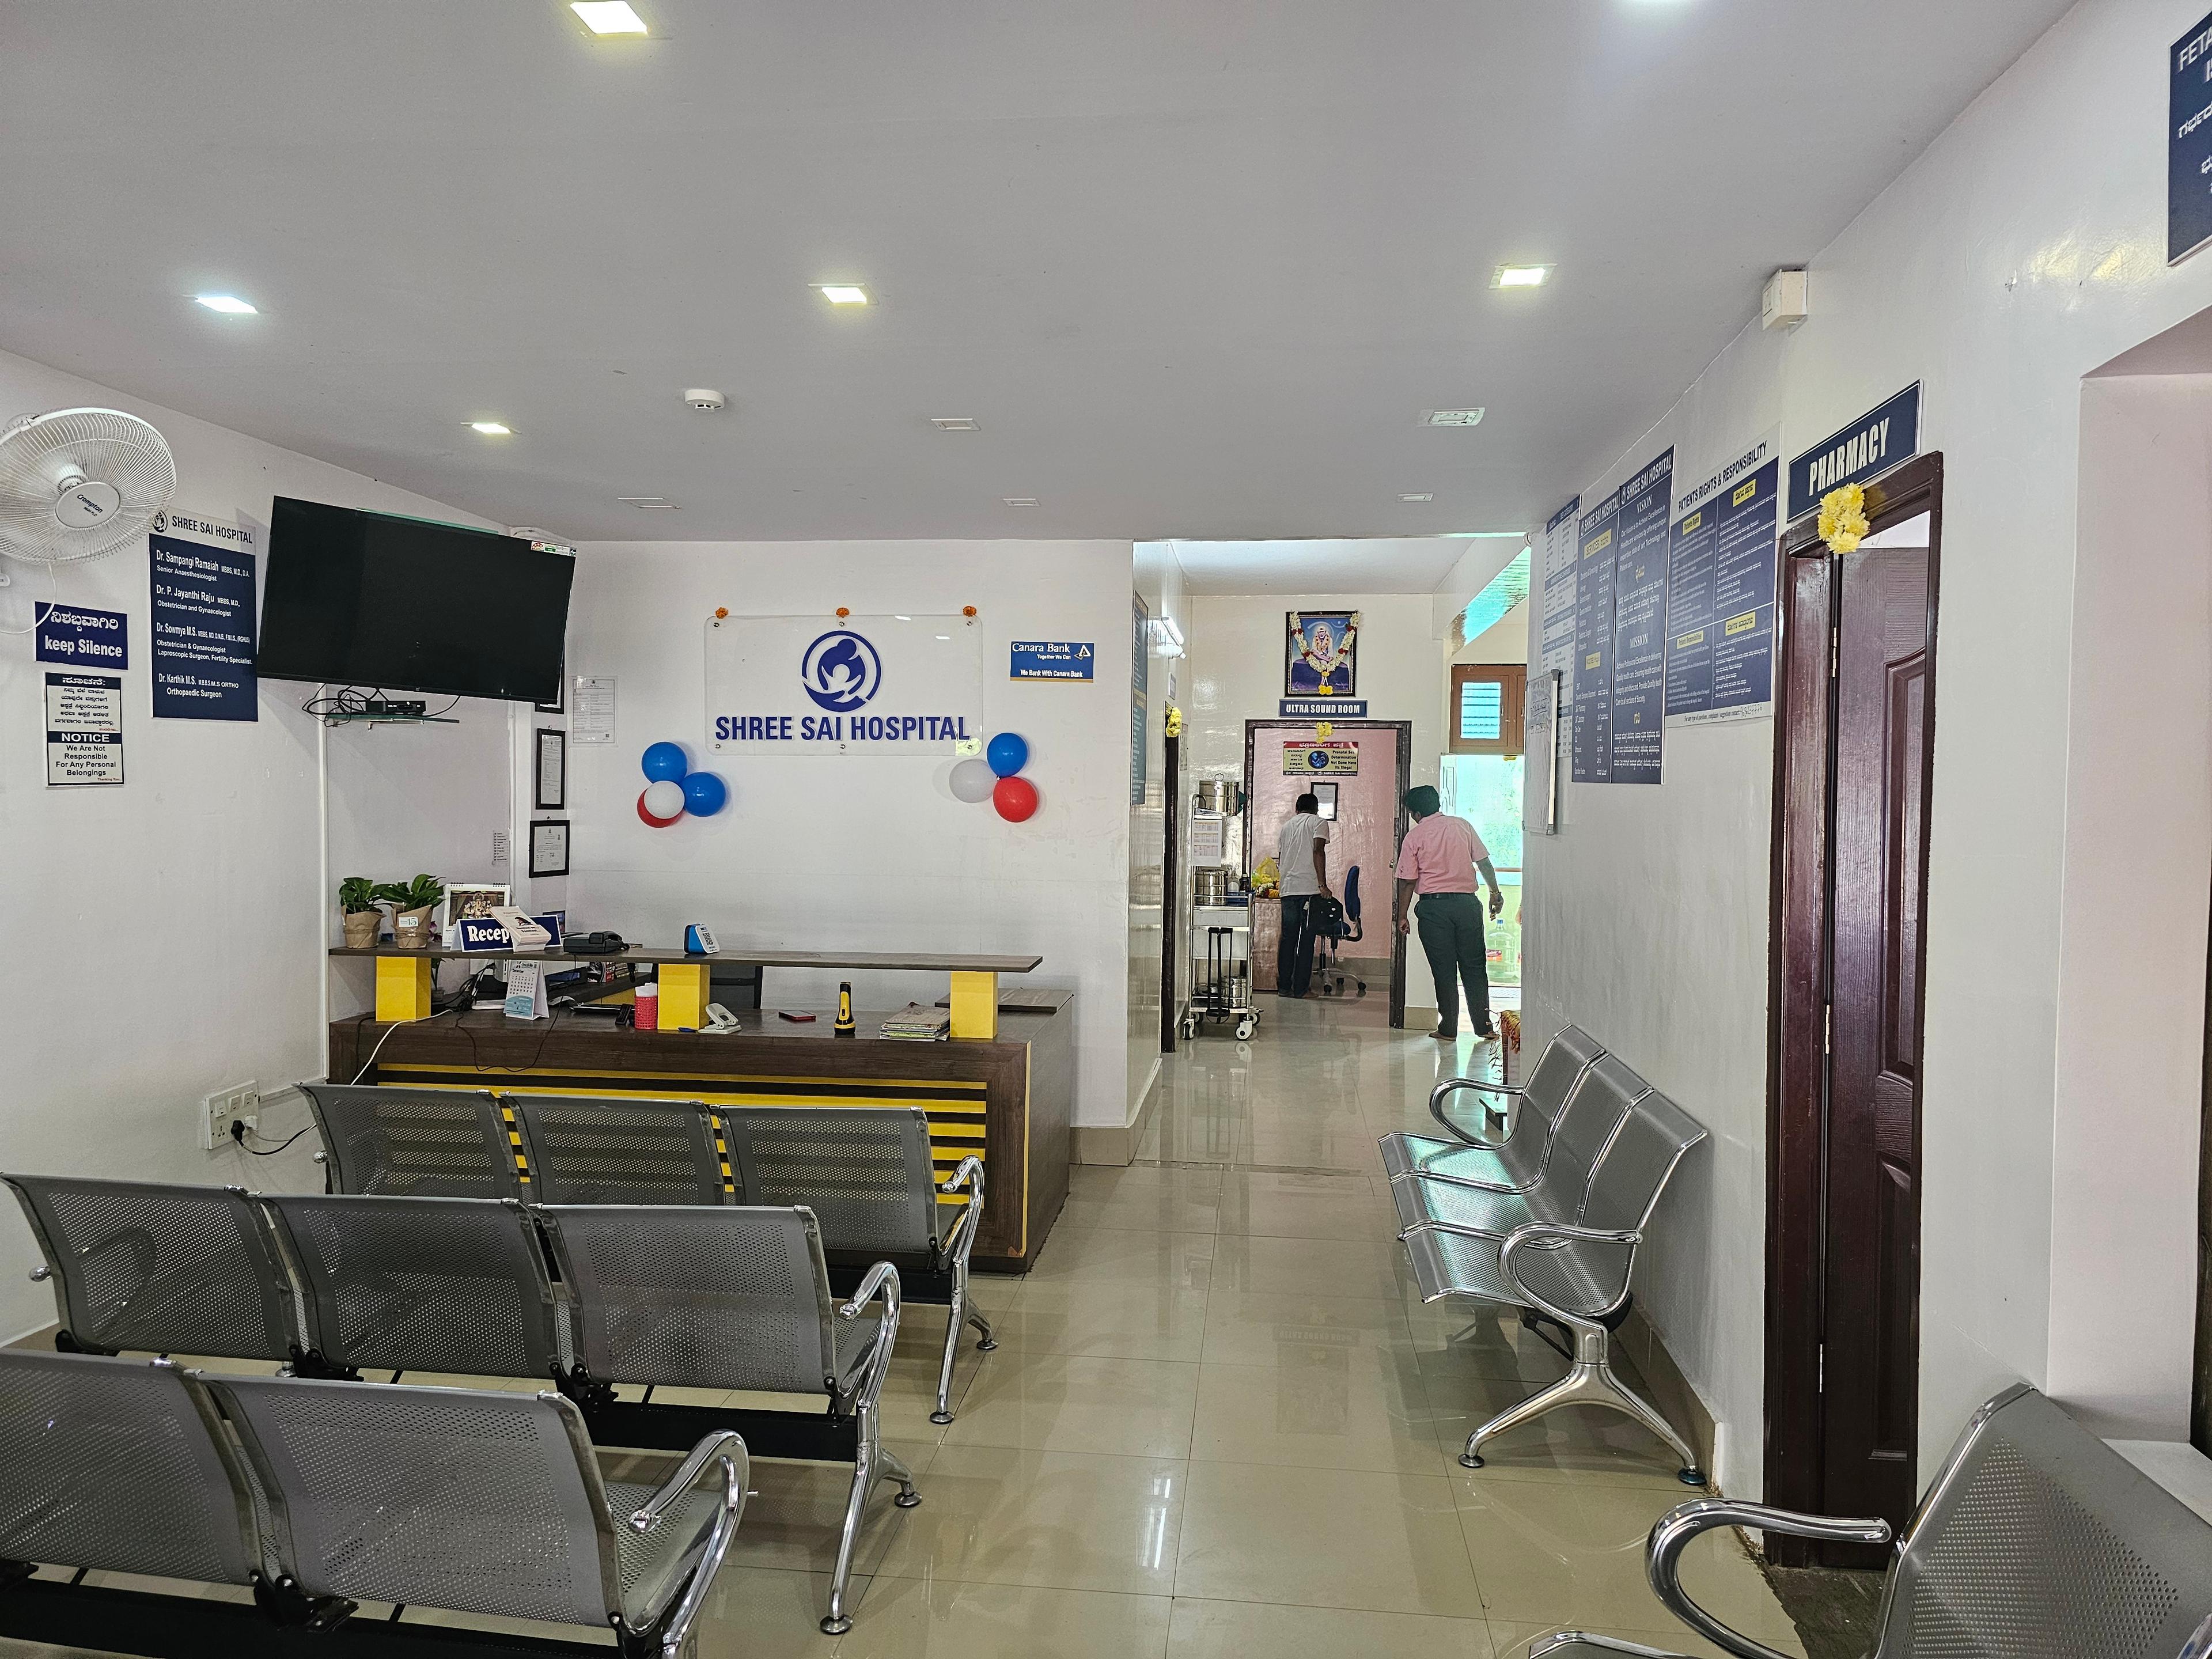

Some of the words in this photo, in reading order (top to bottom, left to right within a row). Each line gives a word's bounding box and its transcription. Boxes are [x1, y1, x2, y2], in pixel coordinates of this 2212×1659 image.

[1809, 417, 1889, 497] PHARMACY
[1627, 478, 1640, 500] SHREE
[1649, 454, 1672, 483] HOSPITAL
[1679, 488, 1698, 513] PATIENTS
[1699, 476, 1717, 499] RIGHTS
[1718, 472, 1722, 486] &
[1722, 440, 1767, 483] RESPONSIBILITY
[77, 494, 103, 513] Crompton
[1637, 494, 1653, 514] VISION
[173, 516, 198, 532] SHREE
[200, 522, 213, 535] SAI
[216, 525, 252, 544] HOSPITAL
[156, 550, 165, 561] Dr.
[166, 551, 194, 569] Sampangi
[195, 556, 219, 571] Ramaiah
[157, 565, 173, 573] Senior
[175, 568, 217, 582] Anaesthesiologist
[156, 584, 165, 594] Dr.
[167, 586, 173, 596] P.
[174, 588, 200, 600] Jayanthi
[201, 592, 214, 604] Raju
[157, 600, 187, 610] Obstetrician
[198, 607, 231, 617] Gynaecologist
[165, 623, 186, 637] Sowmya
[187, 626, 197, 637] M.S.
[45, 635, 75, 655] keep
[78, 639, 122, 657] Silence
[157, 639, 187, 649] Obstetrician
[192, 643, 226, 654] Gynaecologist
[1012, 643, 1044, 652] Canara
[1047, 643, 1070, 653] Bank
[1630, 633, 1649, 649] MISSION
[158, 649, 188, 659] Laproscopic
[189, 652, 211, 661] Surgeon,
[211, 654, 228, 663] Fertility
[167, 674, 185, 684] Karthik
[185, 676, 196, 685] M.S.
[167, 687, 200, 697] Orthopaedic
[200, 690, 222, 699] Surgeon
[1286, 704, 1309, 713] ULTRA
[1310, 704, 1336, 714] SOUND
[1338, 704, 1360, 714] ROOM
[715, 716, 793, 741] SHREE
[801, 716, 842, 741] SAI
[851, 716, 971, 741] HOSPITAL
[61, 733, 110, 743] NOTICE
[467, 925, 510, 944] Recep
